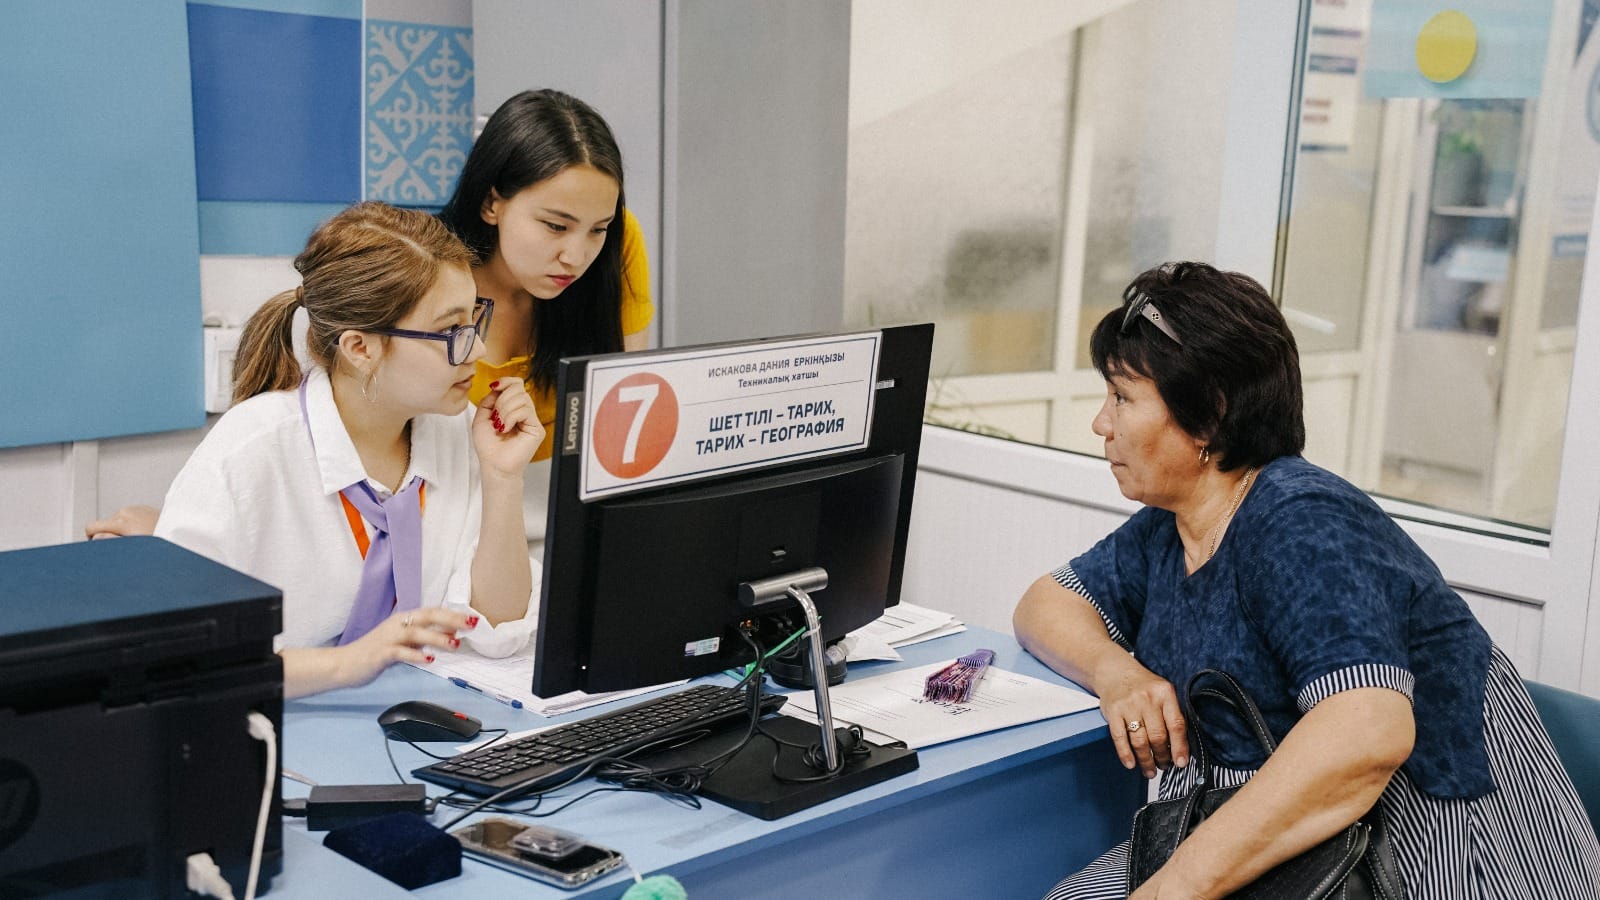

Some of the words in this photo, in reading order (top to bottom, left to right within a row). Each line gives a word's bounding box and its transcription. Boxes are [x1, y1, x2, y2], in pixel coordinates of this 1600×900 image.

[708, 363, 757, 378] ИСКАКОВА
[759, 359, 790, 373] ДАНИЯ
[738, 374, 790, 388] Техникалық
[792, 371, 819, 381] хатшы
[566, 397, 579, 450] Lenovo
[618, 384, 659, 465] 7
[709, 413, 742, 432] ШЕТ
[745, 409, 773, 427] ТІЛІ
[788, 400, 836, 420] ТАРИХ,
[696, 434, 745, 455] ТАРИХ
[760, 417, 845, 445] ГЕОГРАФИЯ
